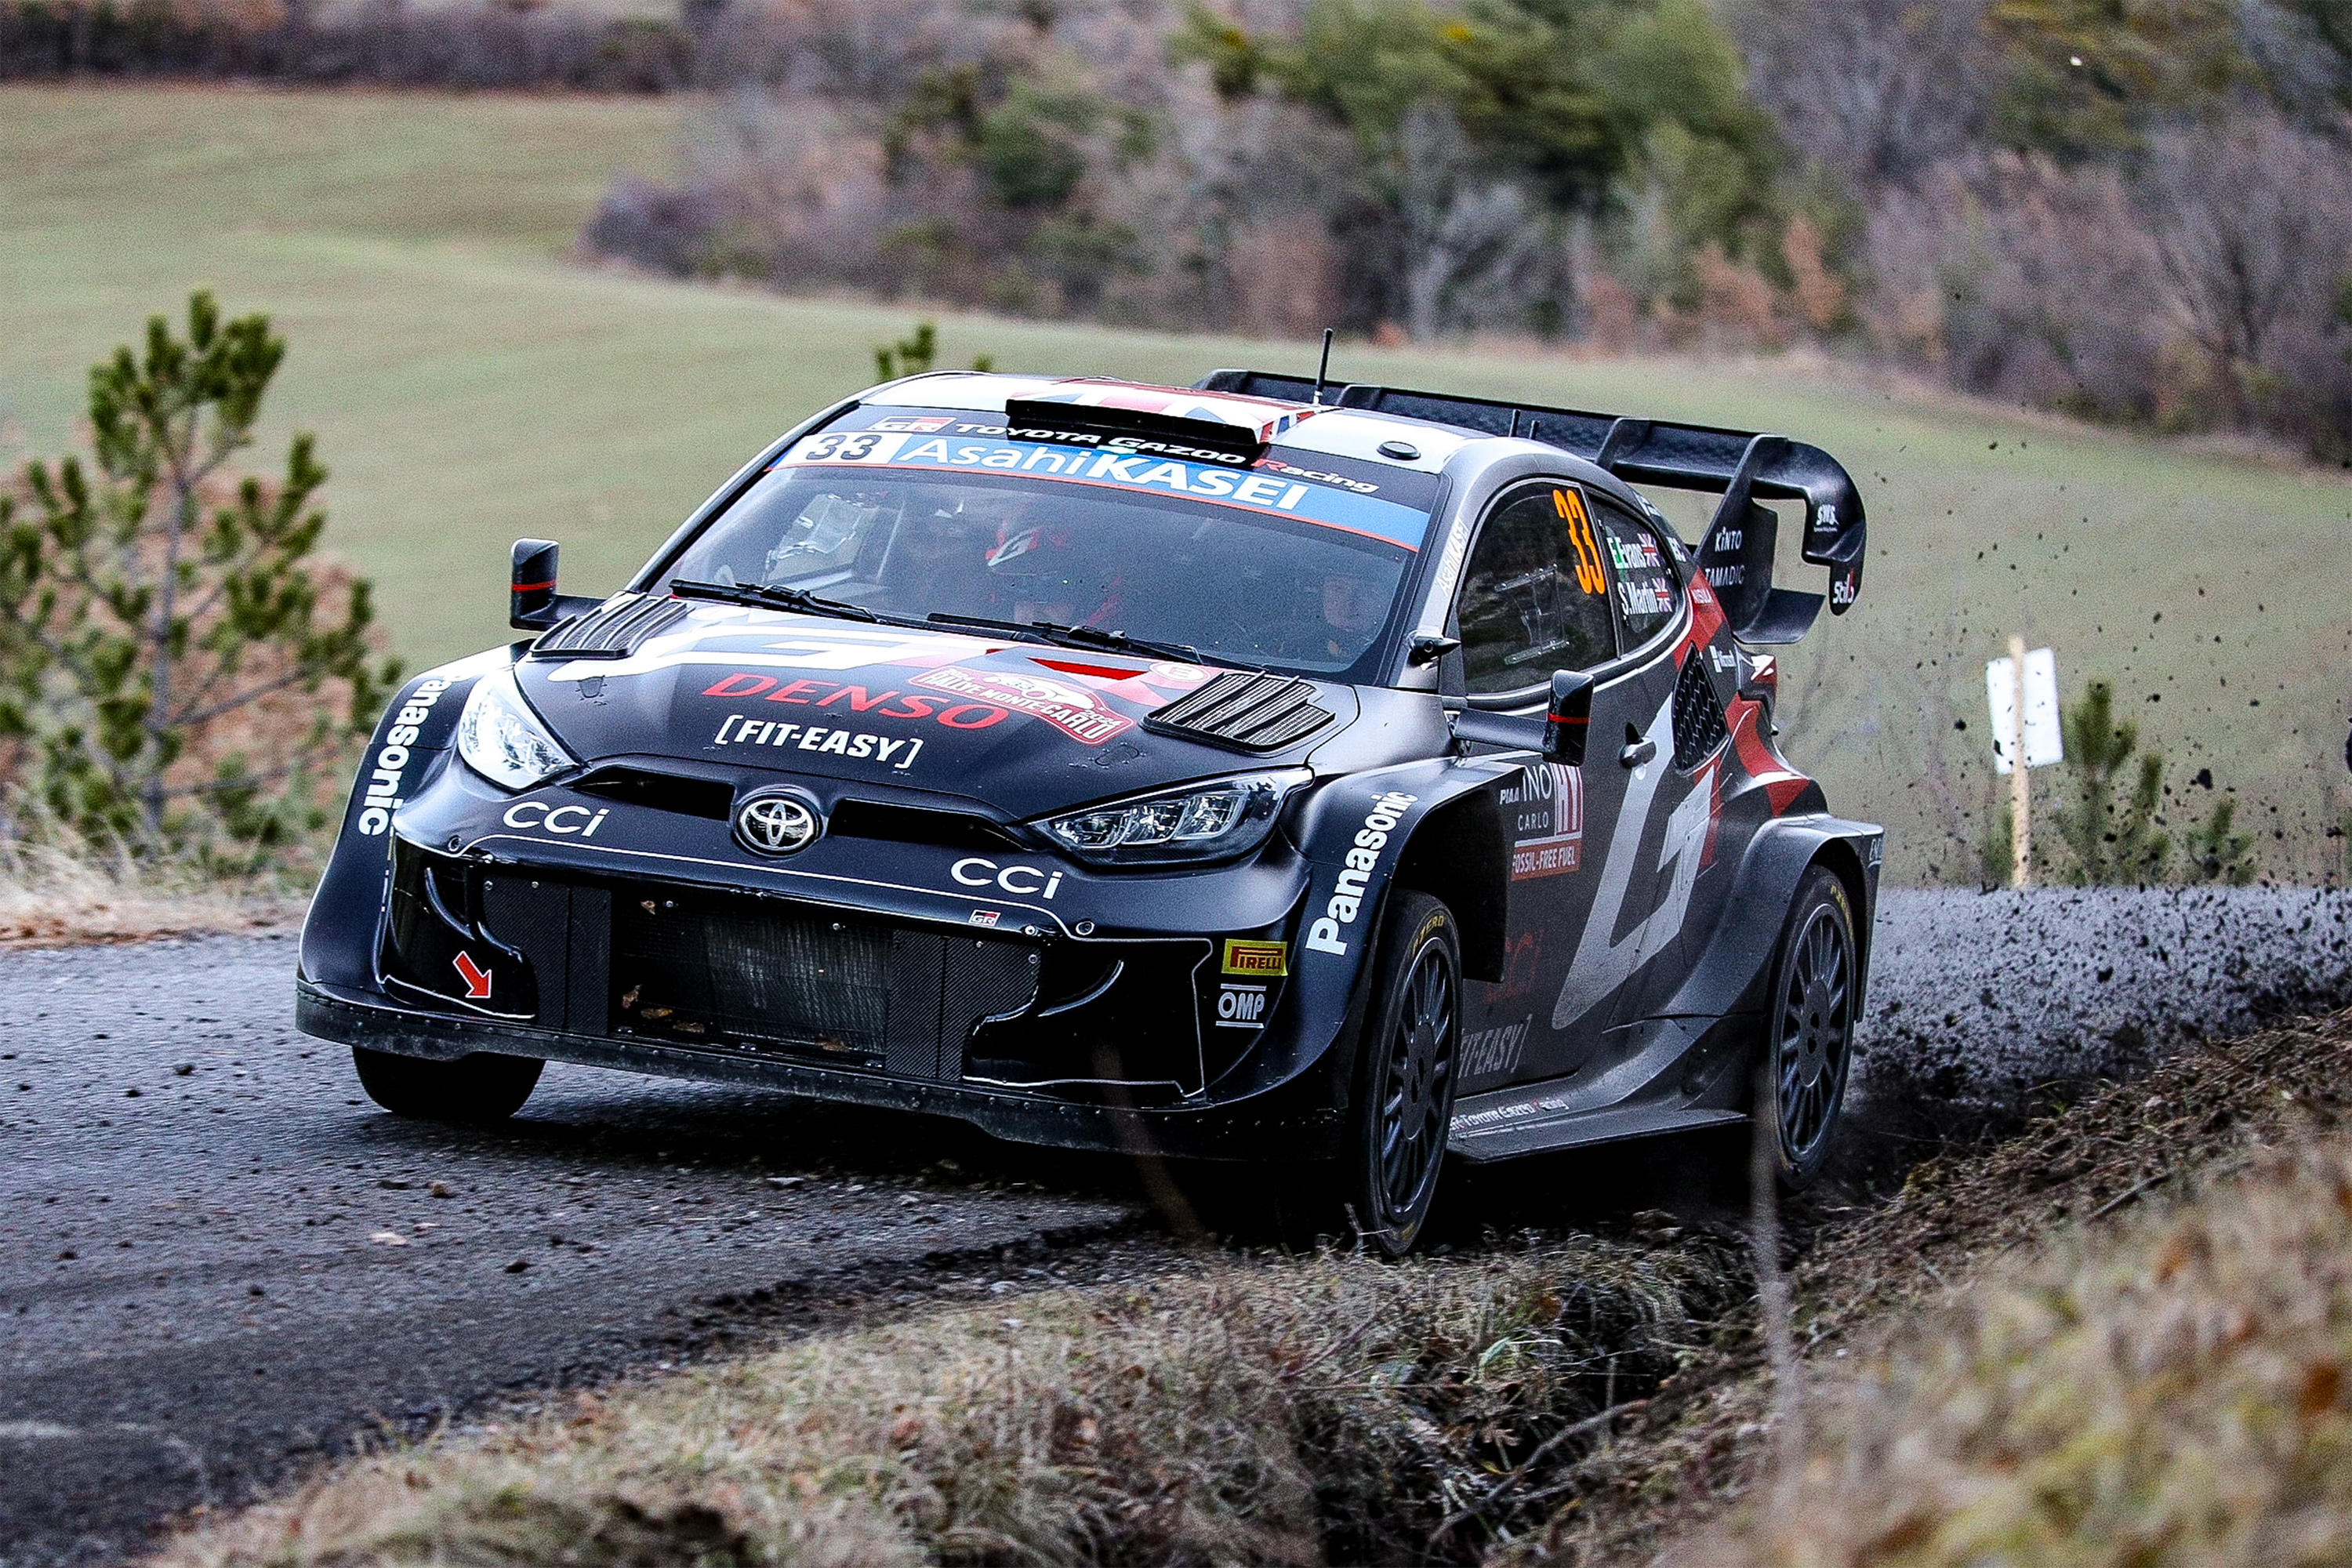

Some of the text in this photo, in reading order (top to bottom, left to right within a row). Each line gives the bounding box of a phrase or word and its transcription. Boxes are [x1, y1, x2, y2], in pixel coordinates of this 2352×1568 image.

[806, 434, 883, 460] 33
[956, 423, 1098, 443] TOYOTA
[1108, 437, 1247, 463] GAZOO
[1251, 459, 1380, 494] Racing
[1553, 489, 1606, 594] 33
[1705, 564, 1745, 587] TAMADIC
[917, 672, 986, 694] RALLYE
[702, 673, 1011, 730] DENSO
[1518, 811, 1549, 831] CARLO
[1305, 791, 1419, 956] Panasonic
[1229, 946, 1284, 970] PIRELLI
[1218, 992, 1265, 1020] OMP
